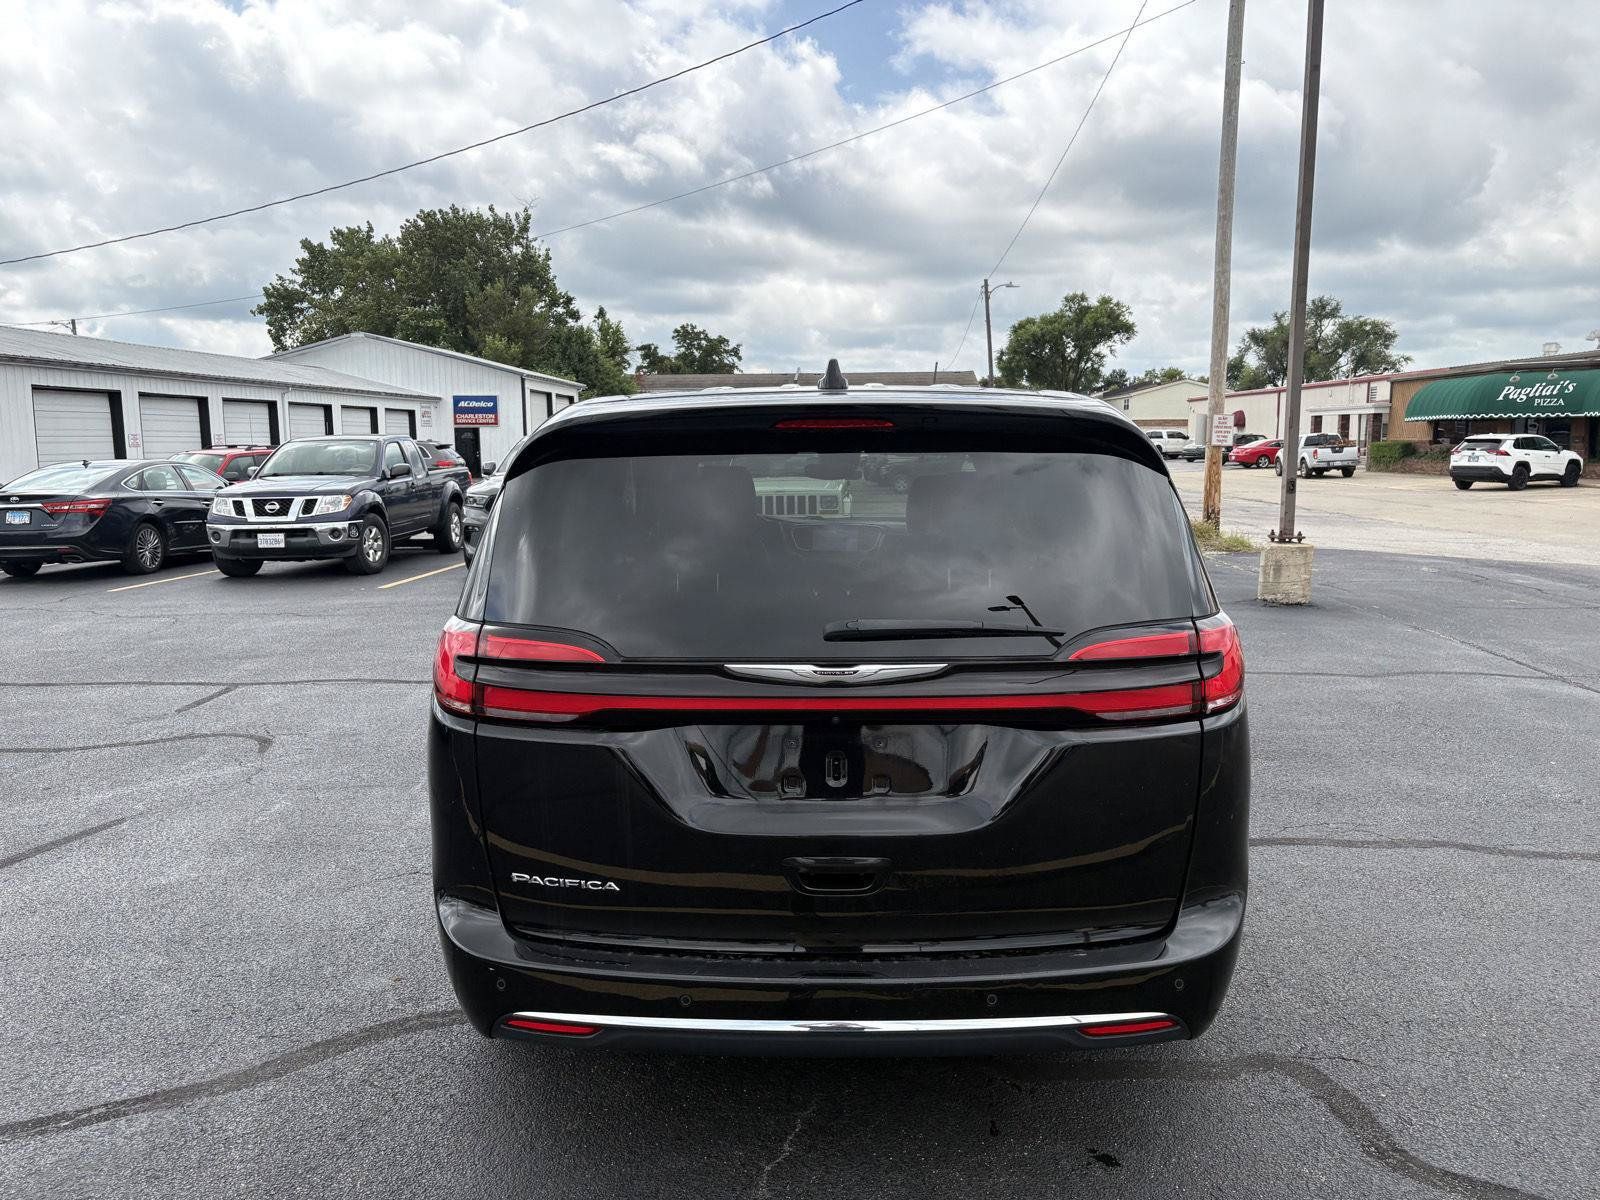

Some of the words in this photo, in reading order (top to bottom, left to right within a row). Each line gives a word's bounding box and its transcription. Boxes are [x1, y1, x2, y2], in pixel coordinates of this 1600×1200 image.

[1496, 380, 1577, 402] Pagliai's
[1534, 398, 1565, 406] PIZZA
[511, 872, 620, 891] PACIFICA
